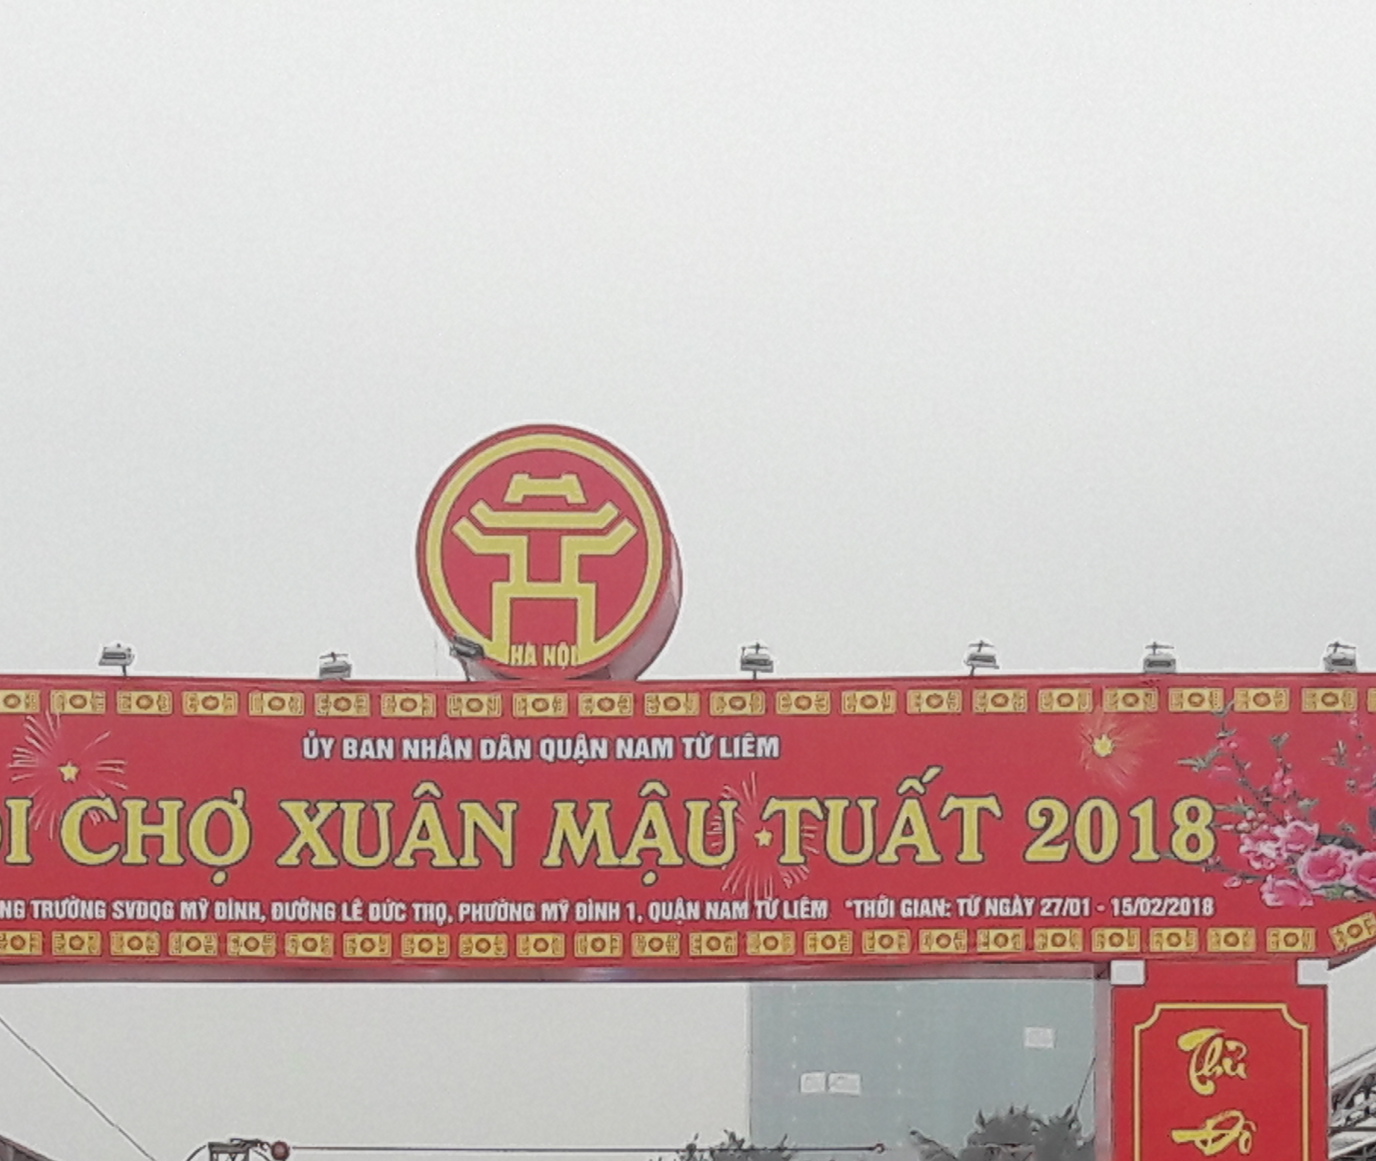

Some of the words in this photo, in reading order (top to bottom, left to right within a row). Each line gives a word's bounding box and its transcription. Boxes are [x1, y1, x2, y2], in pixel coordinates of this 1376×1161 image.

[511, 642, 537, 666] HÀ
[543, 642, 578, 670] NỘI
[303, 729, 335, 760] ỦY
[343, 737, 394, 760] BAN
[402, 734, 472, 760] NHÂN
[480, 734, 531, 760] DÂN
[539, 733, 608, 764] QUẬN
[616, 737, 674, 760] NAM
[682, 732, 714, 759] TỪ
[719, 732, 780, 758] LIÊM
[59, 788, 252, 886] CHỢ
[276, 781, 519, 868] XUÂN
[541, 779, 737, 886] MẬU
[761, 766, 1003, 866] TUẤT
[1023, 796, 1216, 864] 2018
[31, 896, 107, 920] TRƯỜNG
[180, 898, 210, 921] MỸ
[214, 898, 266, 923] ĐÌNH,
[271, 898, 336, 922] ĐƯỜNG
[341, 897, 363, 922] LÊ
[368, 897, 407, 922] ĐỨC
[458, 897, 536, 922] PHƯỜNG
[541, 897, 570, 922] MỸ
[575, 896, 621, 921] ĐÌNH
[648, 897, 700, 925] QUẬN
[705, 900, 749, 921] NAM
[755, 897, 779, 921] TỪ
[783, 896, 829, 920] LIÊM
[900, 896, 952, 918] GIAN:
[957, 895, 984, 917] TỪ
[985, 894, 1036, 917] NGÀY
[1040, 897, 1091, 917] 27/01
[1111, 896, 1215, 917] 15/02/2018
[1177, 1027, 1249, 1096] Thủ
